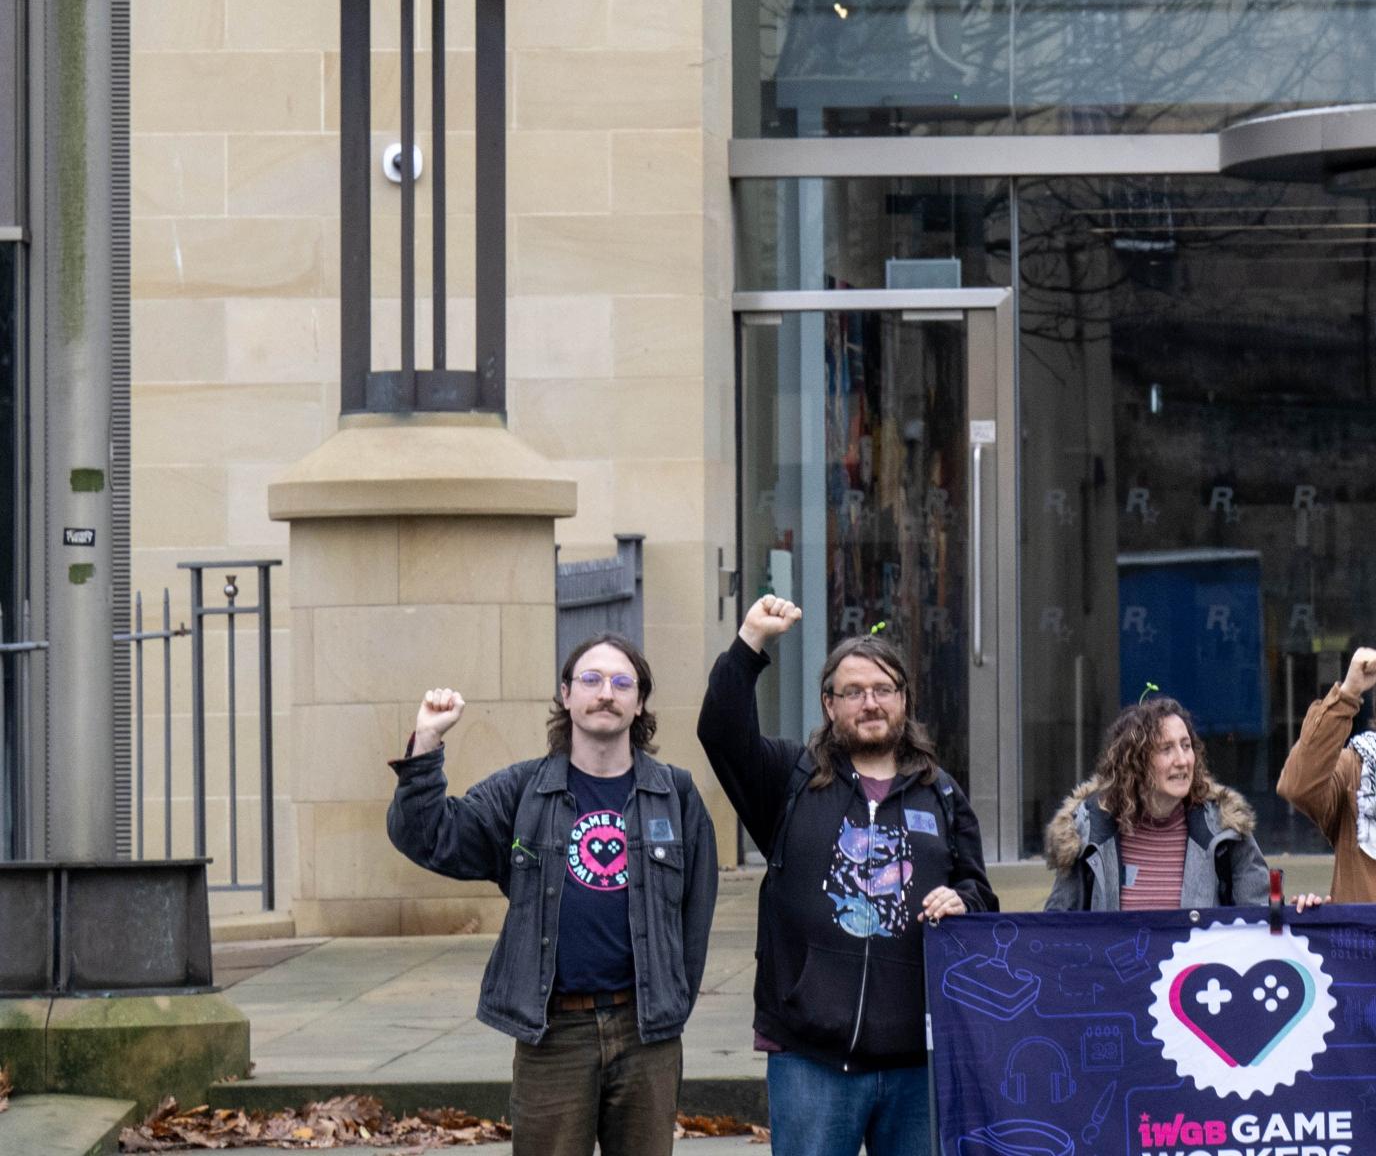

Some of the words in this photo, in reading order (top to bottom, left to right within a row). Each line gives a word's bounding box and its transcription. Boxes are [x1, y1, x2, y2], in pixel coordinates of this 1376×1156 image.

[571, 814, 610, 840] GAME
[568, 844, 594, 884] IWGB
[1231, 1111, 1353, 1144] GAME
